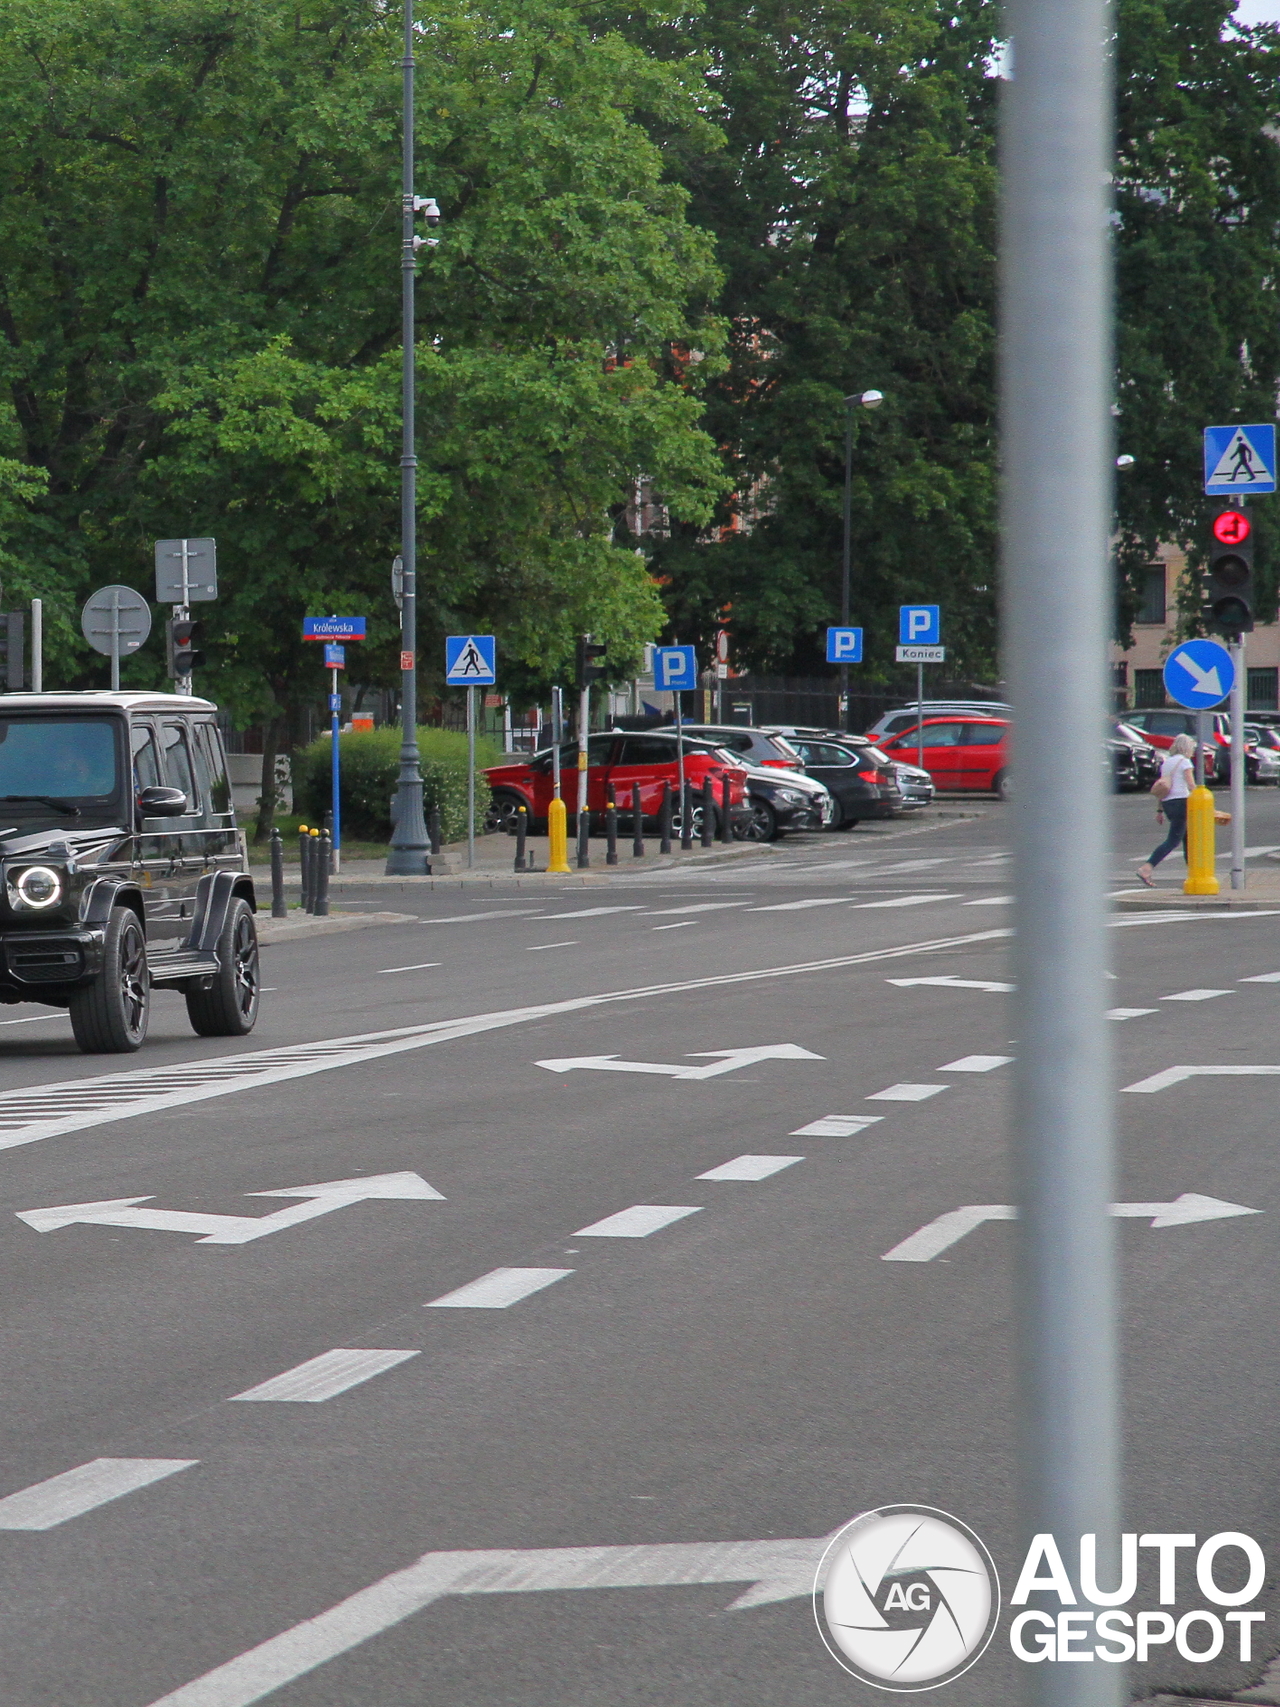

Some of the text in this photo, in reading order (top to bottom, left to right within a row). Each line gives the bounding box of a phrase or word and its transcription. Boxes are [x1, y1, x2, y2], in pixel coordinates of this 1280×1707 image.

[313, 622, 354, 633] Królewska
[908, 609, 931, 640] P
[834, 631, 856, 658] P
[902, 648, 942, 659] Koniec
[662, 651, 686, 686] P
